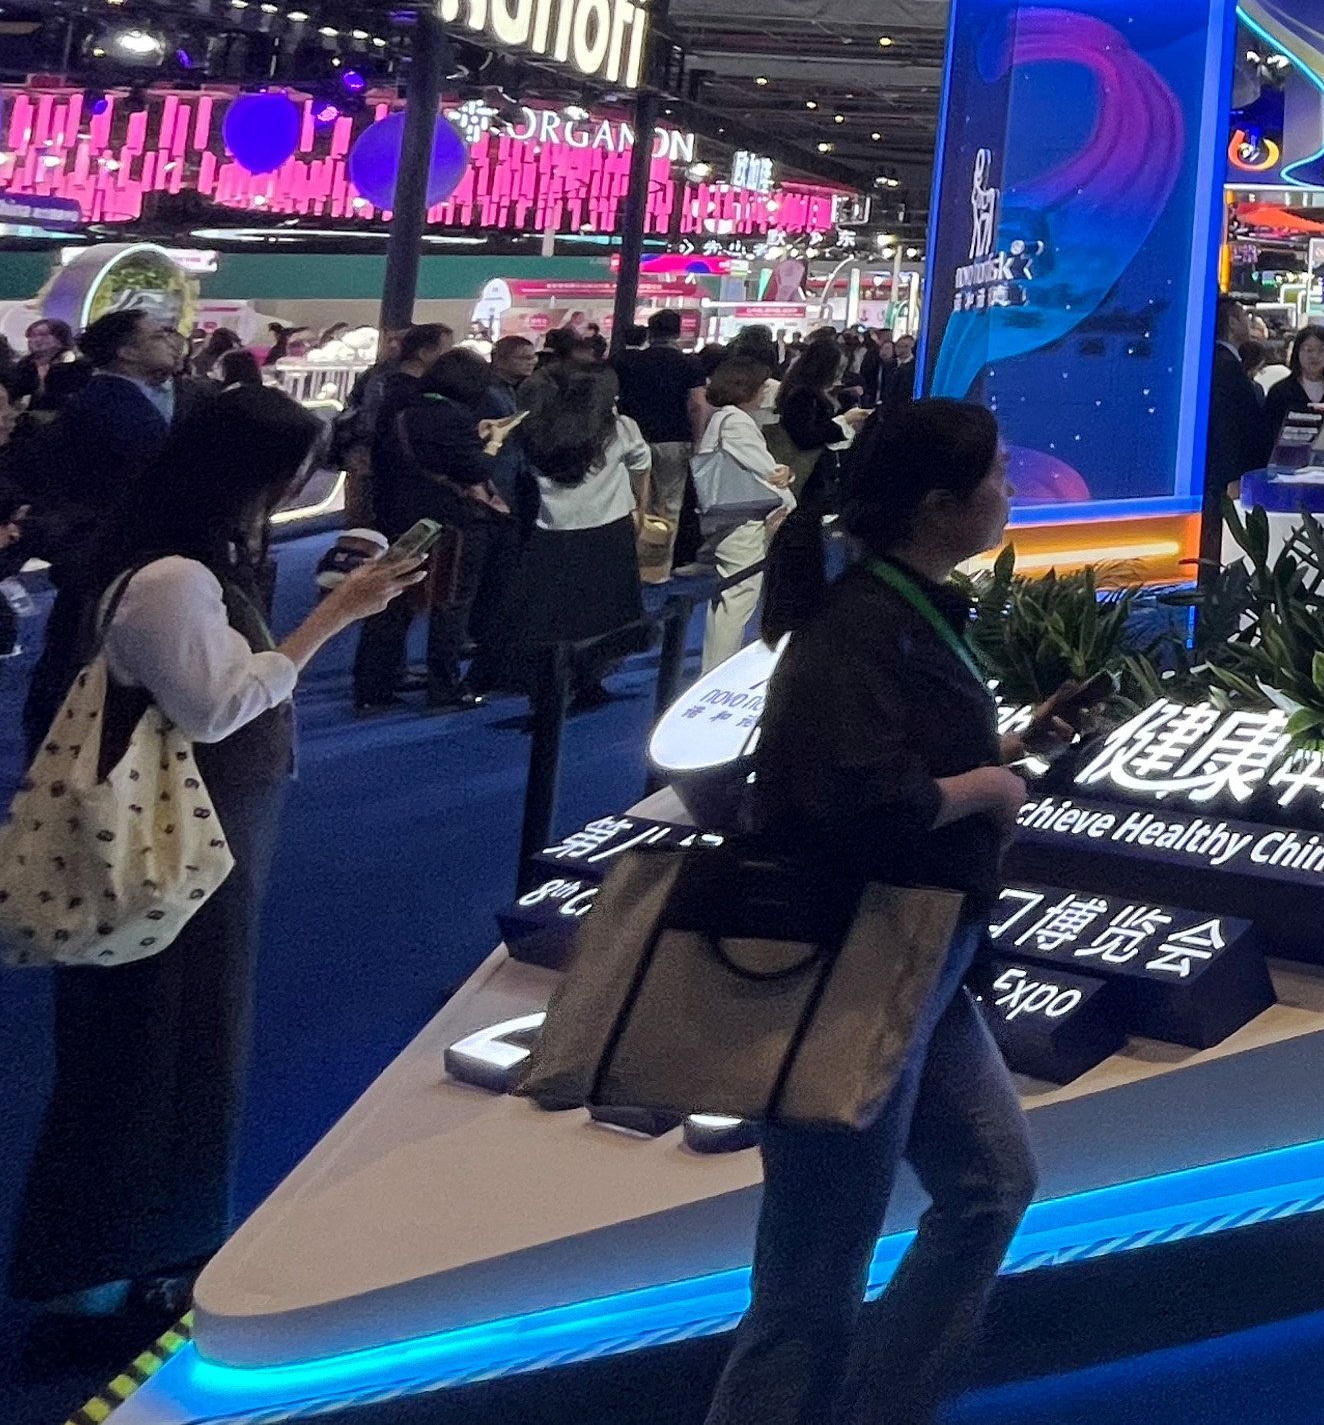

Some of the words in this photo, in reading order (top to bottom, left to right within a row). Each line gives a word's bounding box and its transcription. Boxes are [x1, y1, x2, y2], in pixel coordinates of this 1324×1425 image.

[700, 688, 749, 708] novo
[1016, 797, 1116, 838] chieve
[1112, 811, 1252, 868] Healthy
[993, 968, 1082, 1021] Expo
